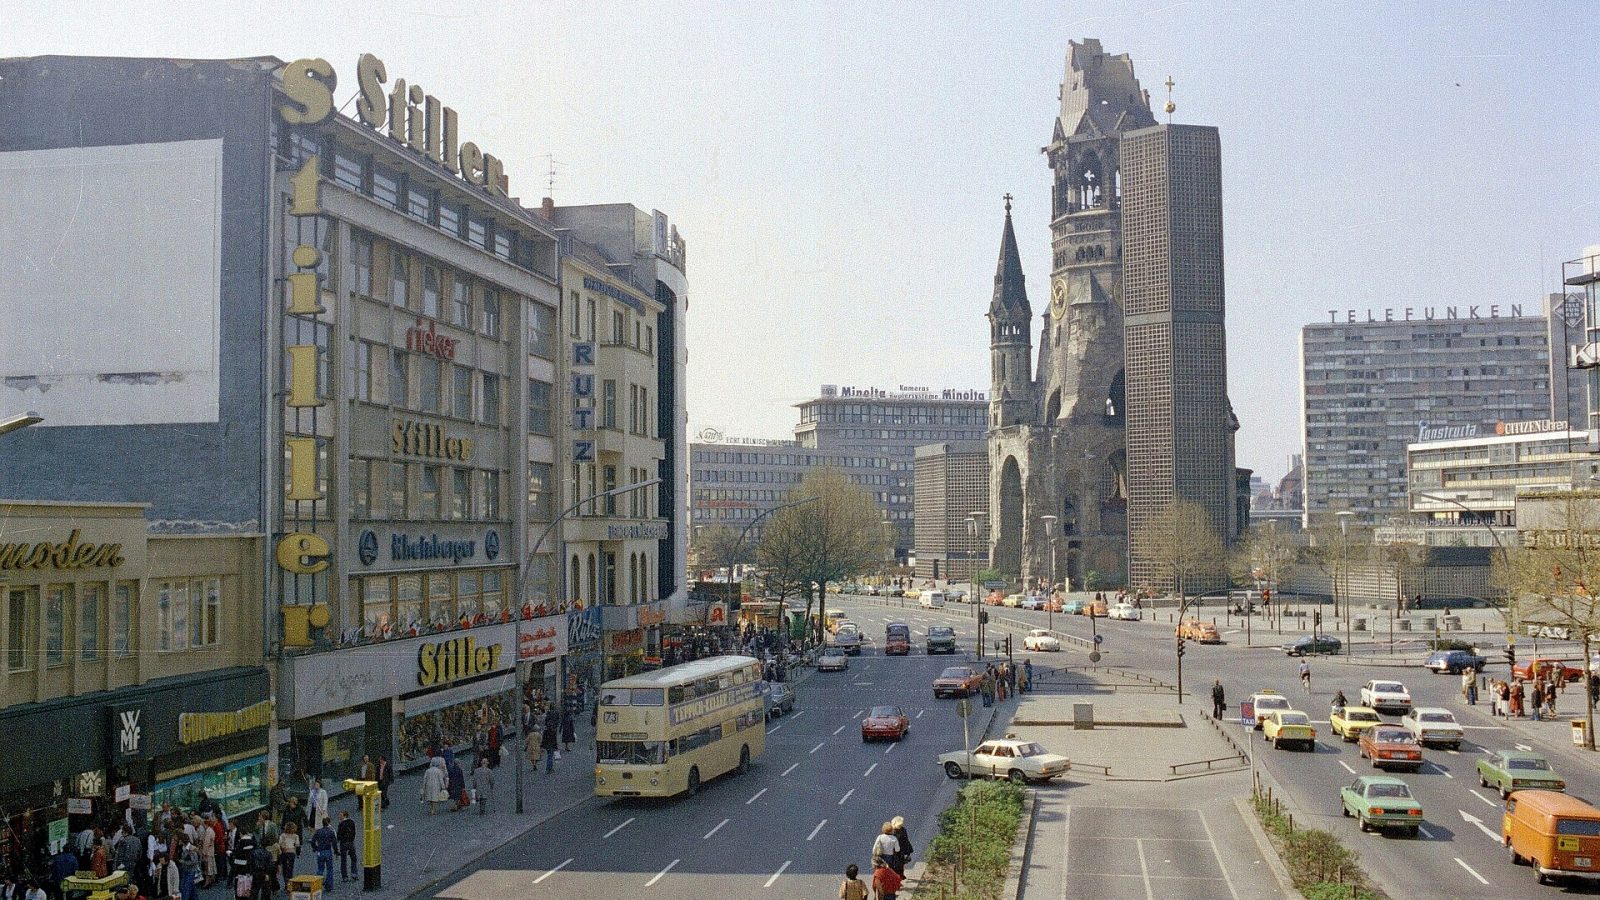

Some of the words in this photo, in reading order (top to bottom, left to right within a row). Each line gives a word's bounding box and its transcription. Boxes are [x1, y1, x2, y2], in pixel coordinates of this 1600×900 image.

[356, 53, 503, 196] Stiller
[1328, 304, 1522, 323] TELEFUNKEN
[277, 58, 337, 648] Stiller
[576, 345, 592, 461] RUTZ
[841, 386, 886, 398] Minolta
[942, 388, 985, 400] Minolta
[392, 417, 474, 462] Stiller
[1418, 420, 1477, 443] Constructa
[1504, 420, 1541, 435] CITIZEN
[391, 533, 476, 564] Rheinberger
[417, 636, 502, 687] Stiller
[605, 713, 617, 723] 73
